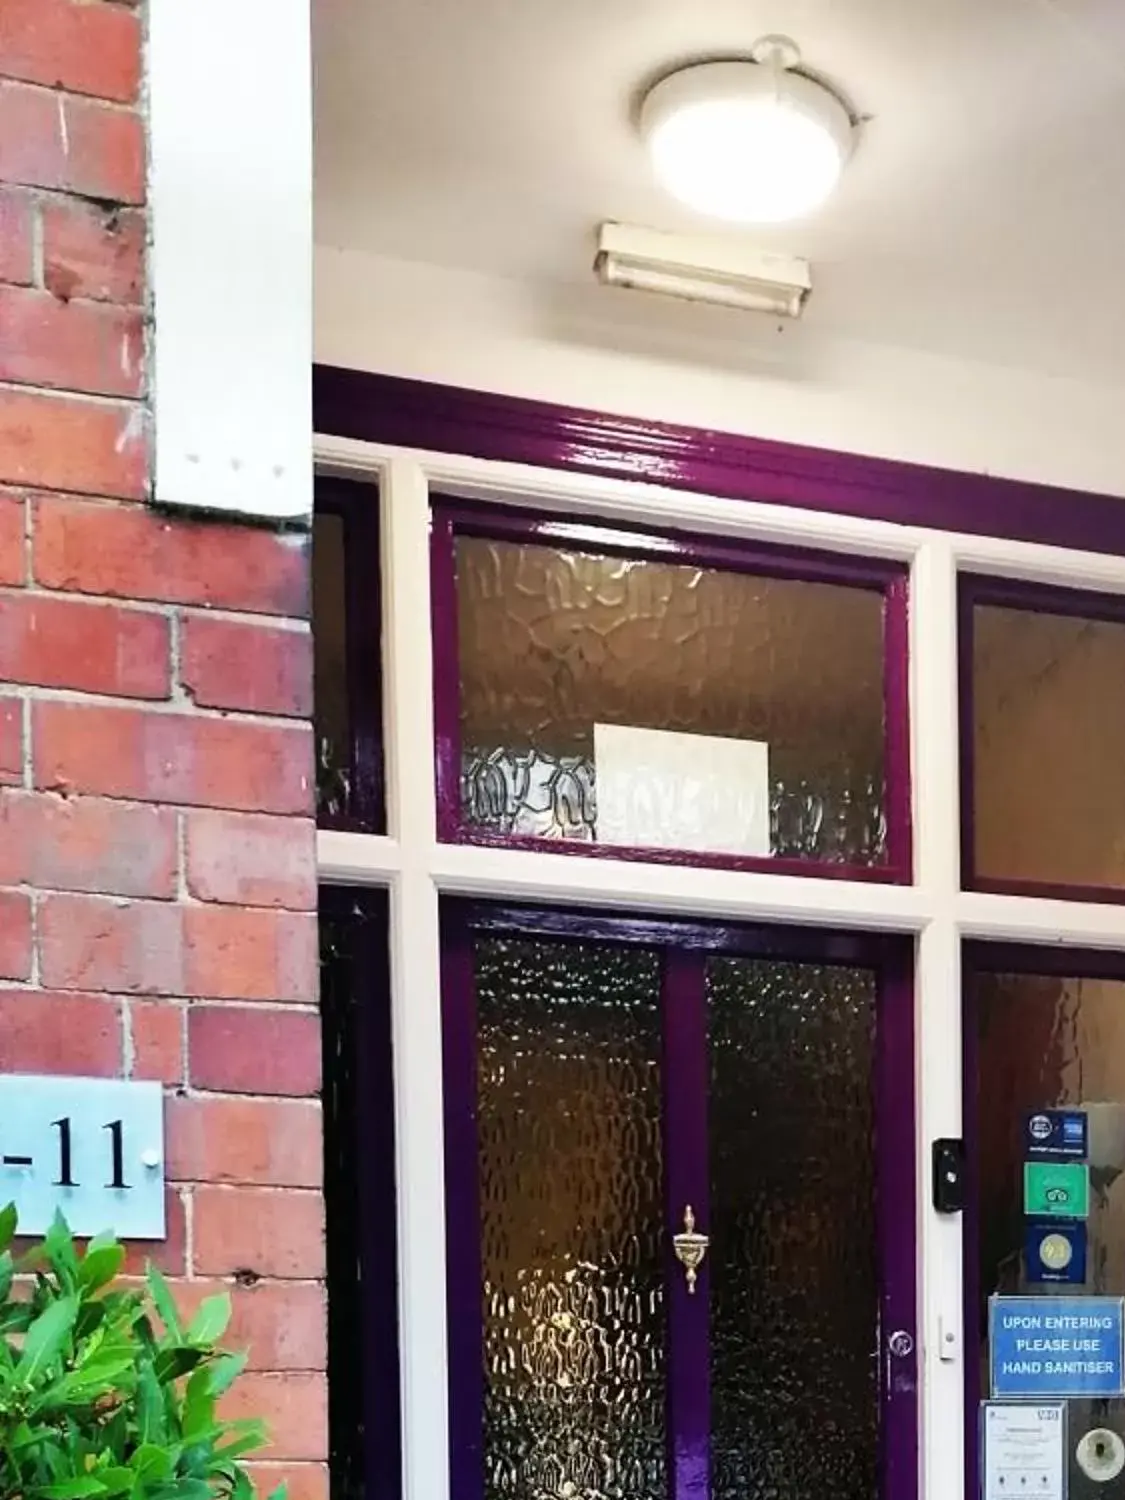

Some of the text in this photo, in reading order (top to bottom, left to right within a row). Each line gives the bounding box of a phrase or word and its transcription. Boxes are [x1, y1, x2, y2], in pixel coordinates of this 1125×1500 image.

[1003, 1316, 1112, 1329] UPON ENTERING
[1017, 1338, 1101, 1351] PLEASE USE
[1003, 1361, 1114, 1374] HAND SANITISER
